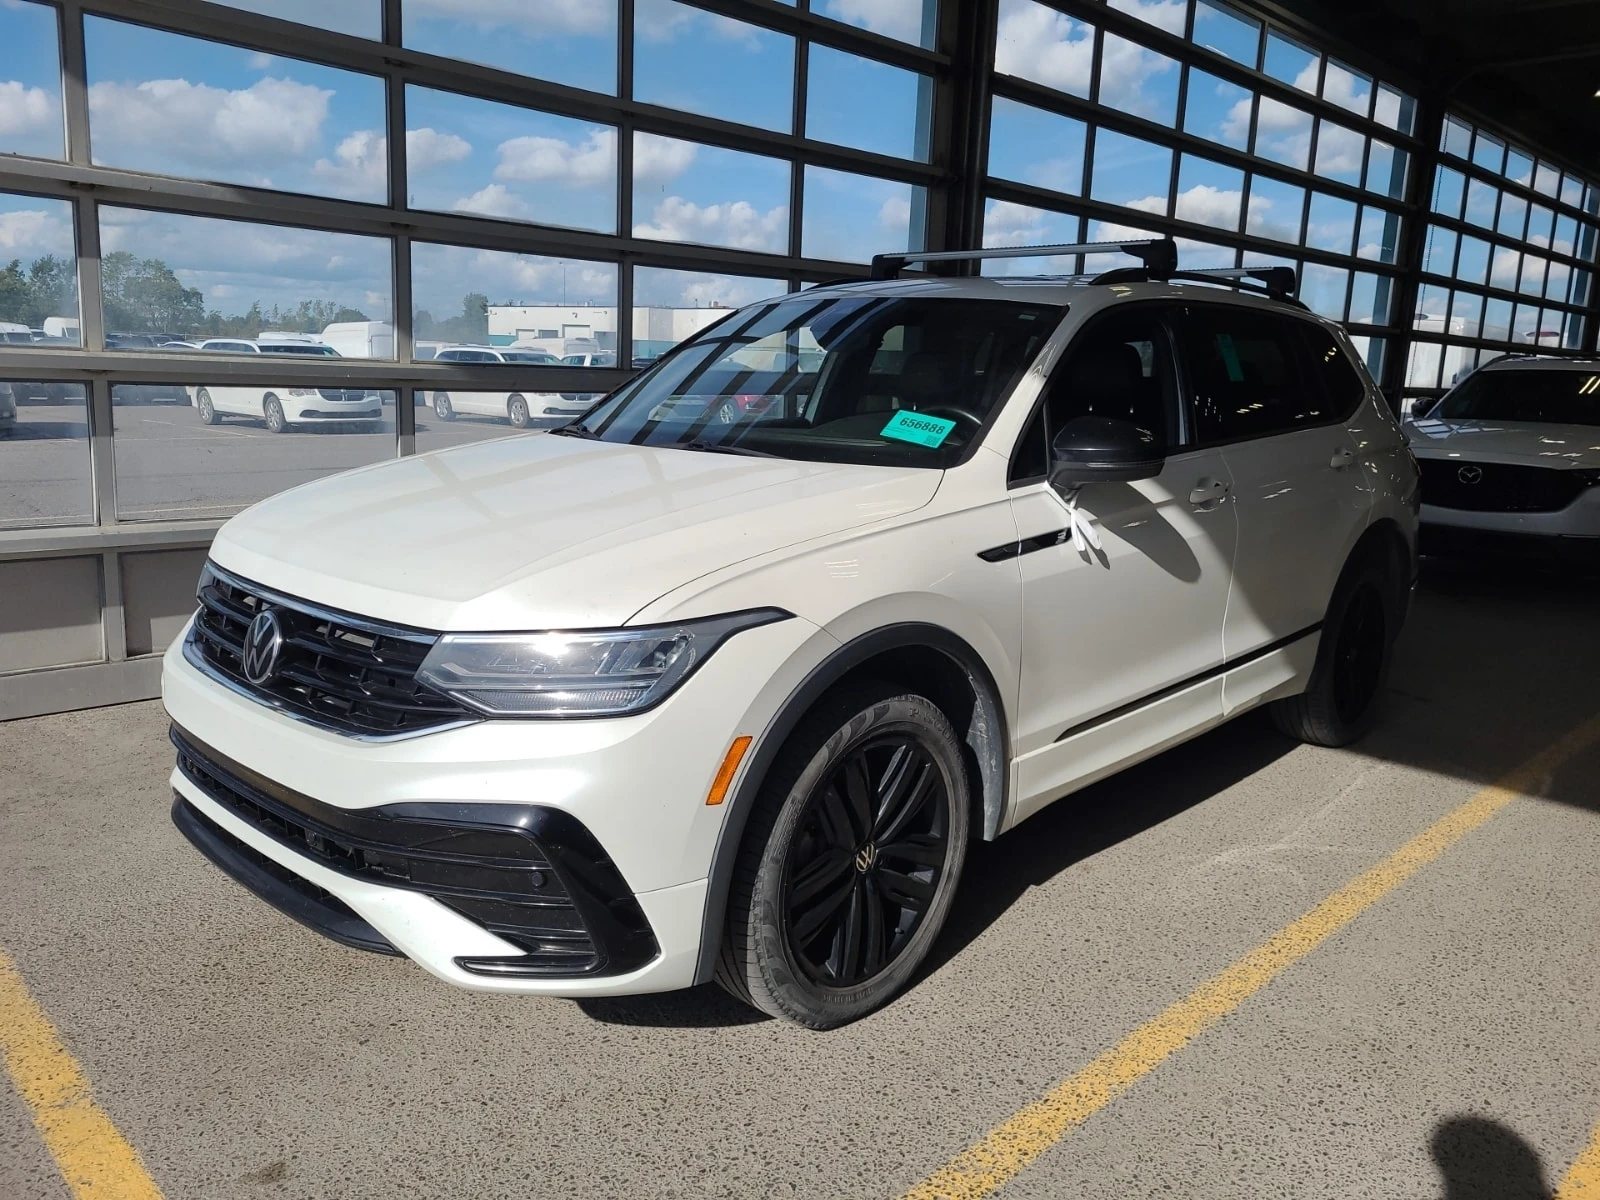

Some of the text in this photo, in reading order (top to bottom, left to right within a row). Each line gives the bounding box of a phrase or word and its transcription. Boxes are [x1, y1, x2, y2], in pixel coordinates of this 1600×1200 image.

[899, 417, 946, 435] 656888
[244, 610, 280, 683] VW
[855, 843, 874, 872] VW
